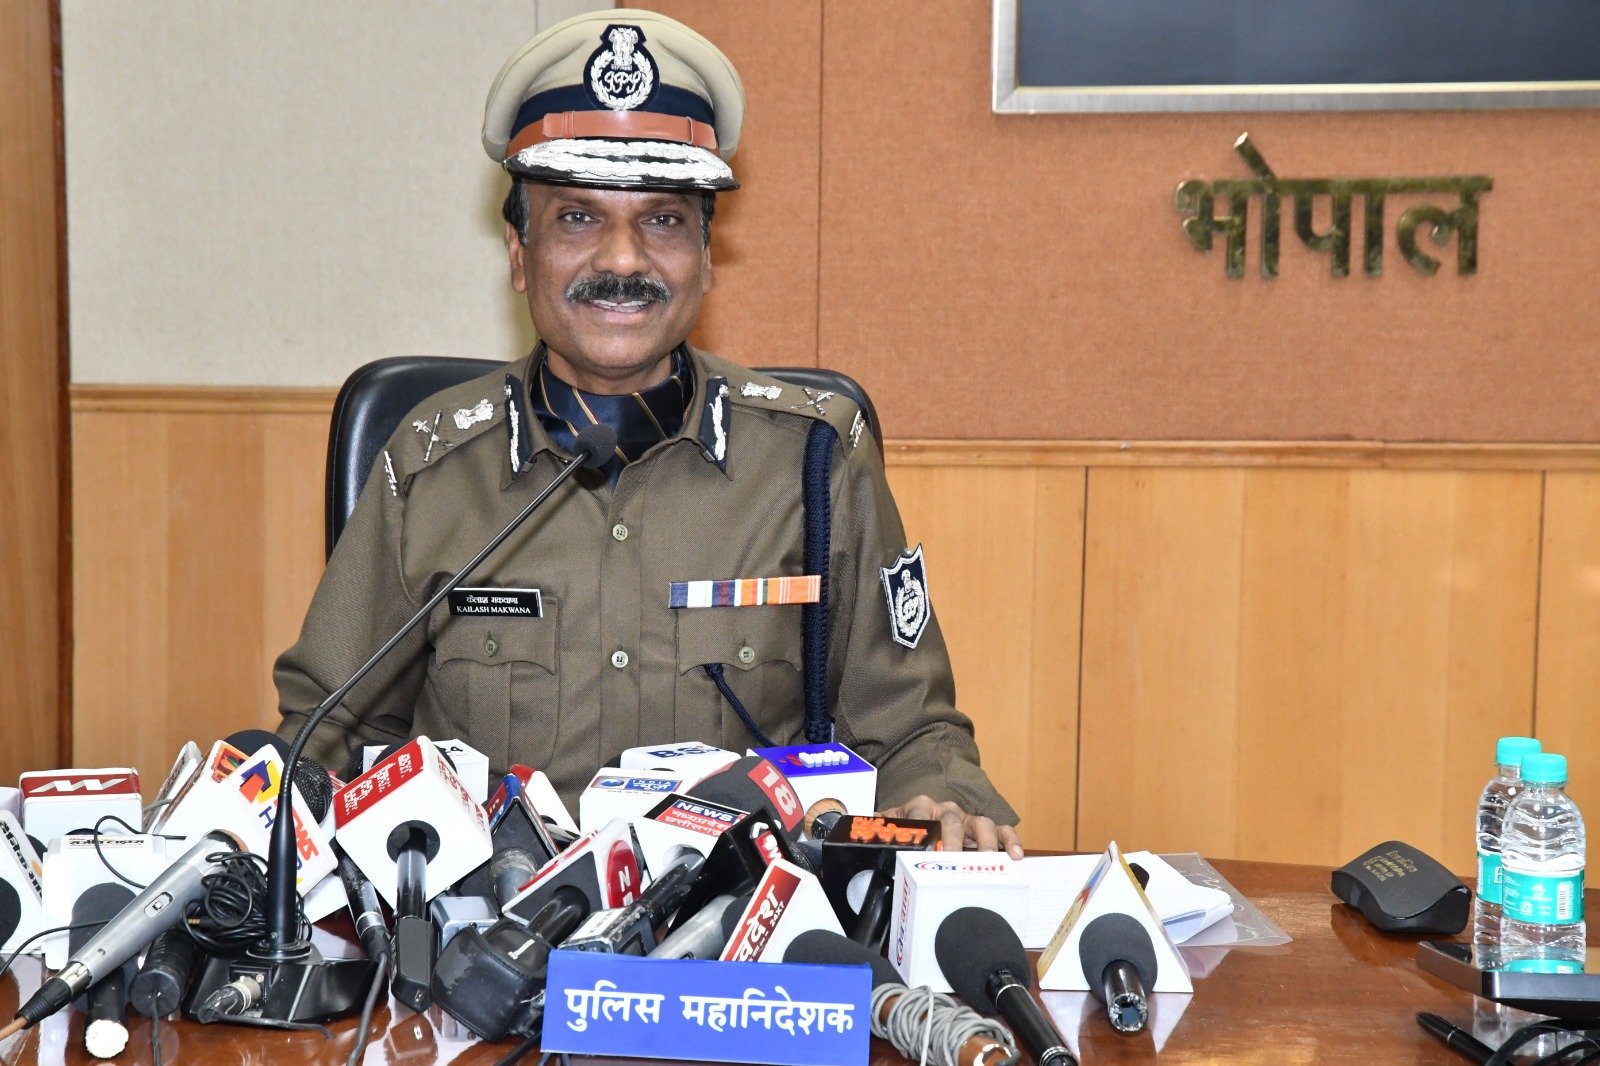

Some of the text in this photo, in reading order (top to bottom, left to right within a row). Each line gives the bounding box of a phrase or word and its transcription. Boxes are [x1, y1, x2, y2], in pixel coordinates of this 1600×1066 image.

[1174, 131, 1494, 279] भोपाल
[491, 606, 531, 614] MAKWANA
[676, 801, 733, 822] NEWS
[762, 765, 797, 816] 18
[732, 884, 778, 962] वदेश
[769, 901, 784, 928] 24X7
[563, 980, 855, 1036] पुलिस महानिदेशक
